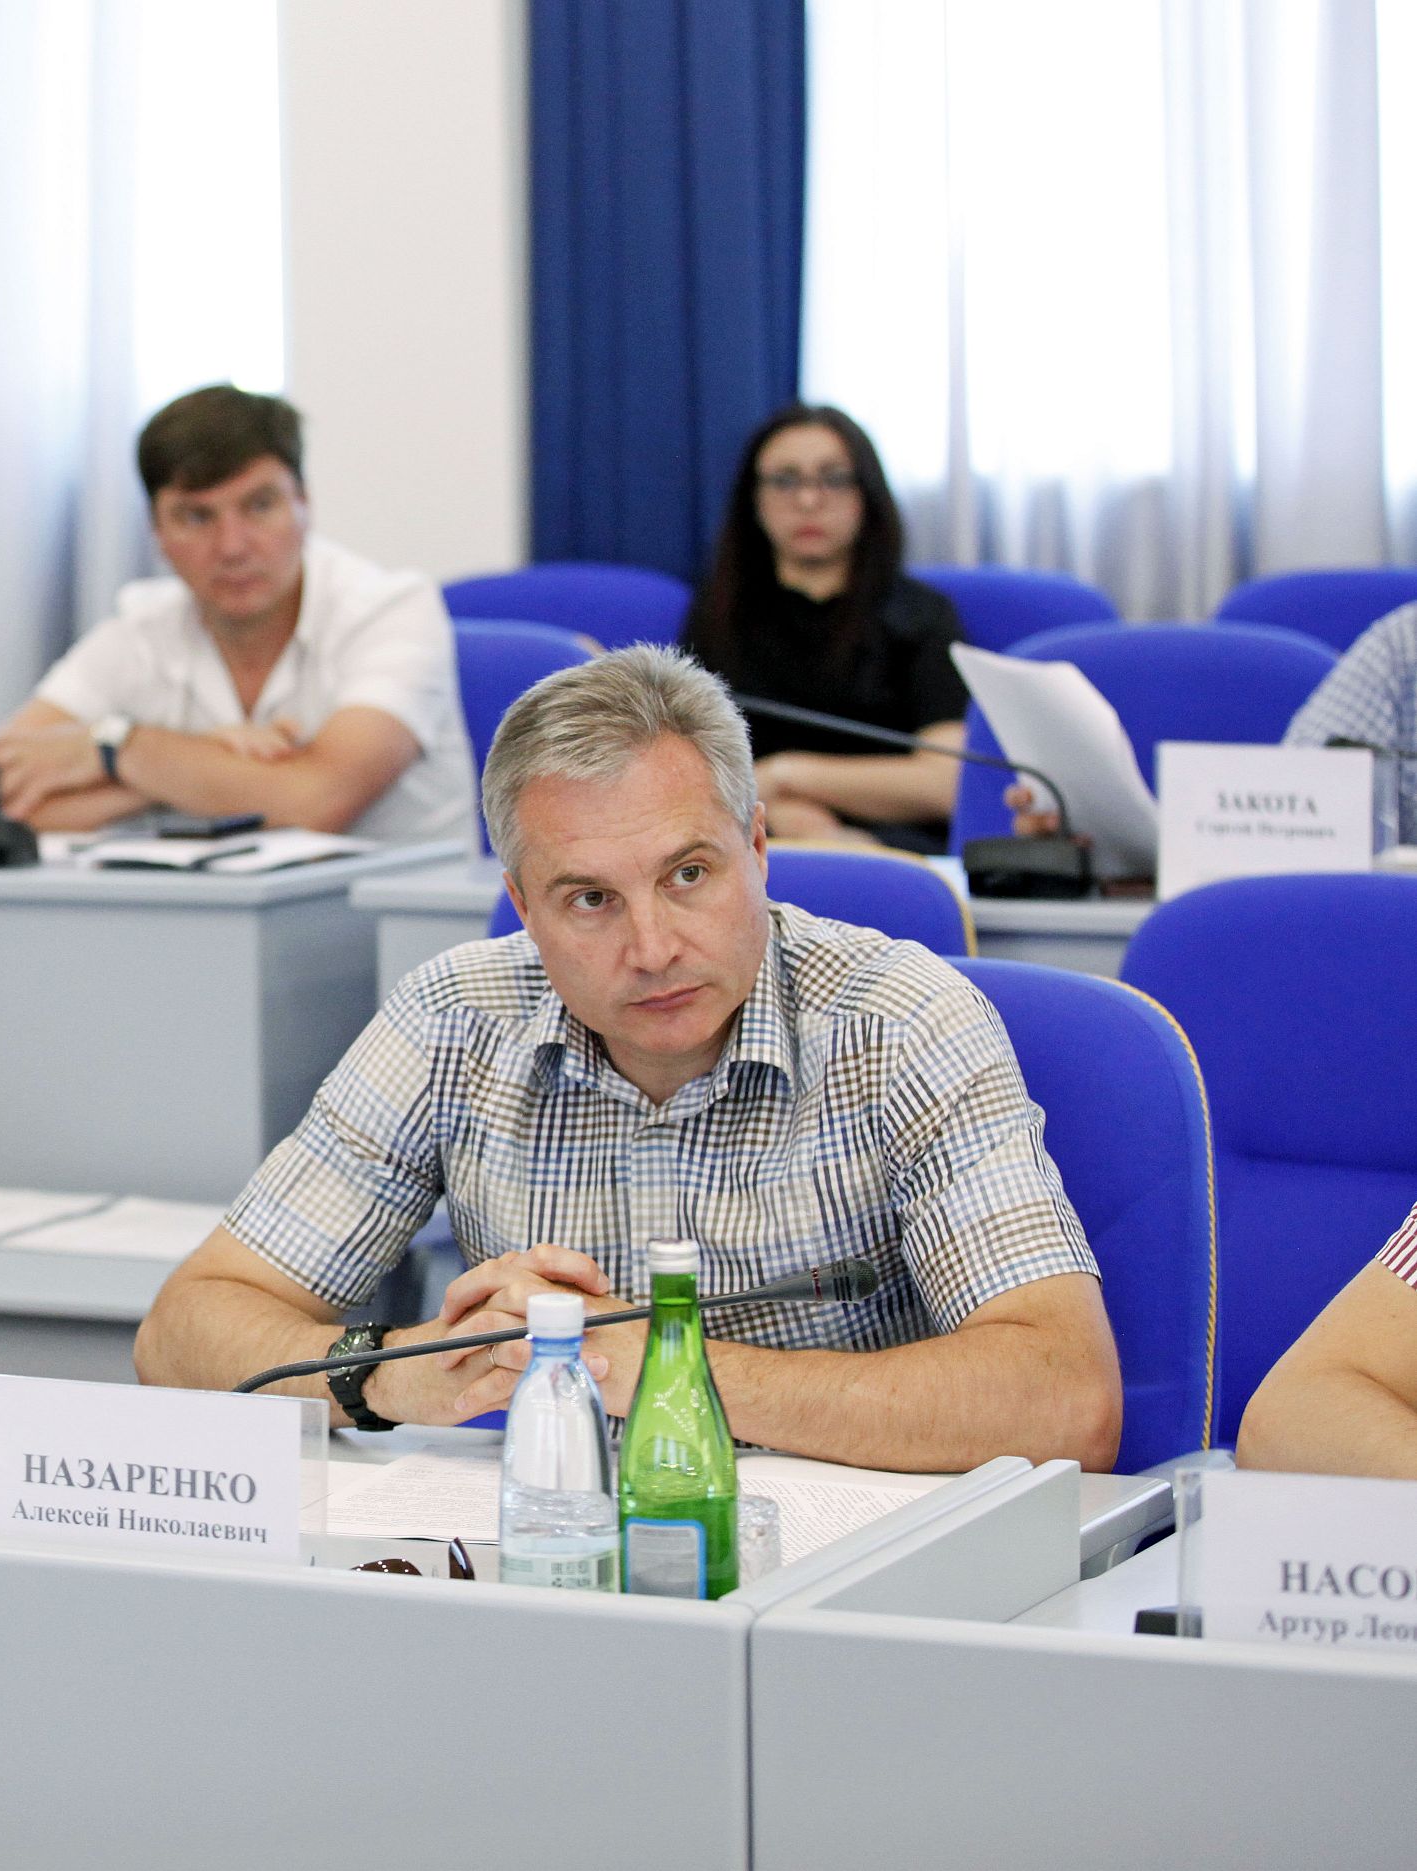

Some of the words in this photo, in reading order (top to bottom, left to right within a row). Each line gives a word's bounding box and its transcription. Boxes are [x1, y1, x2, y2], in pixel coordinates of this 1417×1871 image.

[23, 1453, 257, 1505] НАЗАРЕНКО
[12, 1498, 110, 1530] Алексей
[118, 1508, 268, 1544] Николаевич
[1281, 1560, 1417, 1600] НАСО
[1259, 1610, 1348, 1642] Артур
